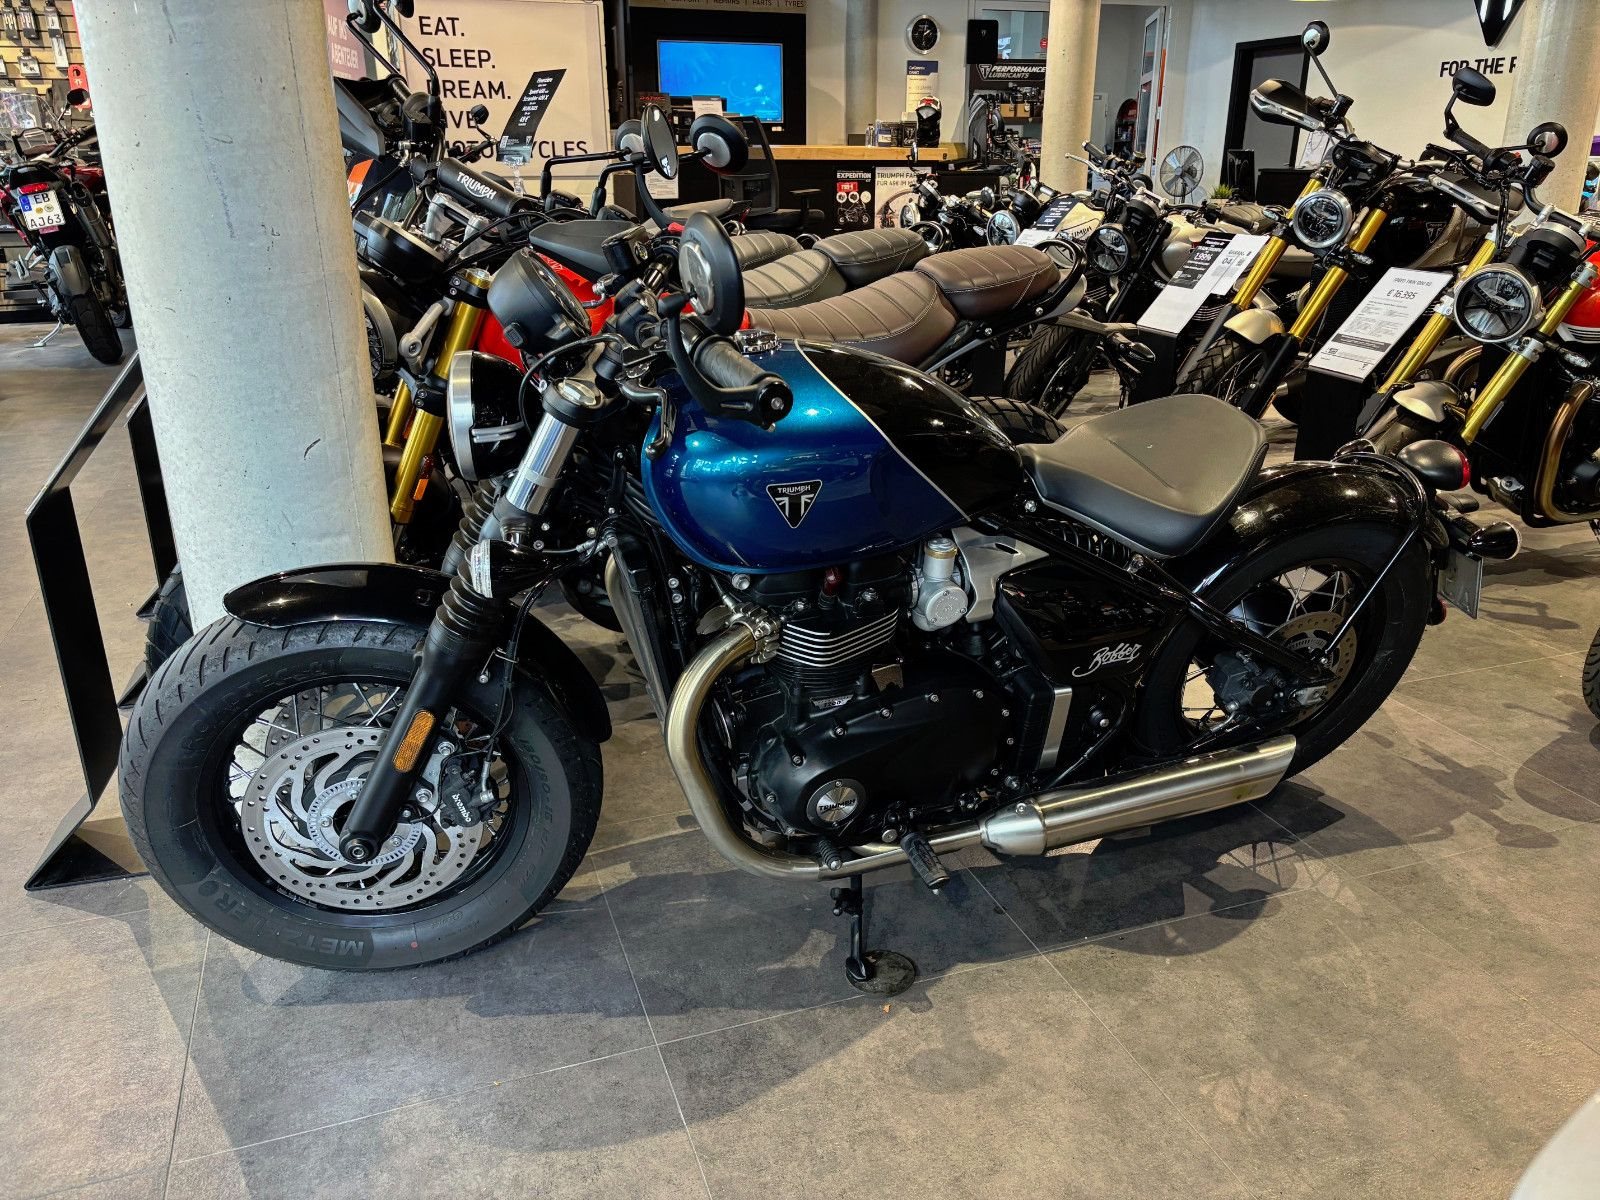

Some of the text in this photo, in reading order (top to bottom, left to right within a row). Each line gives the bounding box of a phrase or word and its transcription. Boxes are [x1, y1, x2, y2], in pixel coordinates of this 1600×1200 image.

[418, 15, 465, 37] EAT.
[422, 47, 496, 69] SLEEP.
[1475, 57, 1506, 74] THE
[991, 65, 1048, 73] PERFORMANCE
[456, 171, 497, 200] TRIUMPH
[33, 192, 51, 204] EB
[777, 484, 811, 495] TRIUMPH
[451, 793, 472, 823] brembo
[818, 798, 856, 811] TRIUMPH
[213, 892, 365, 958] METZLER
